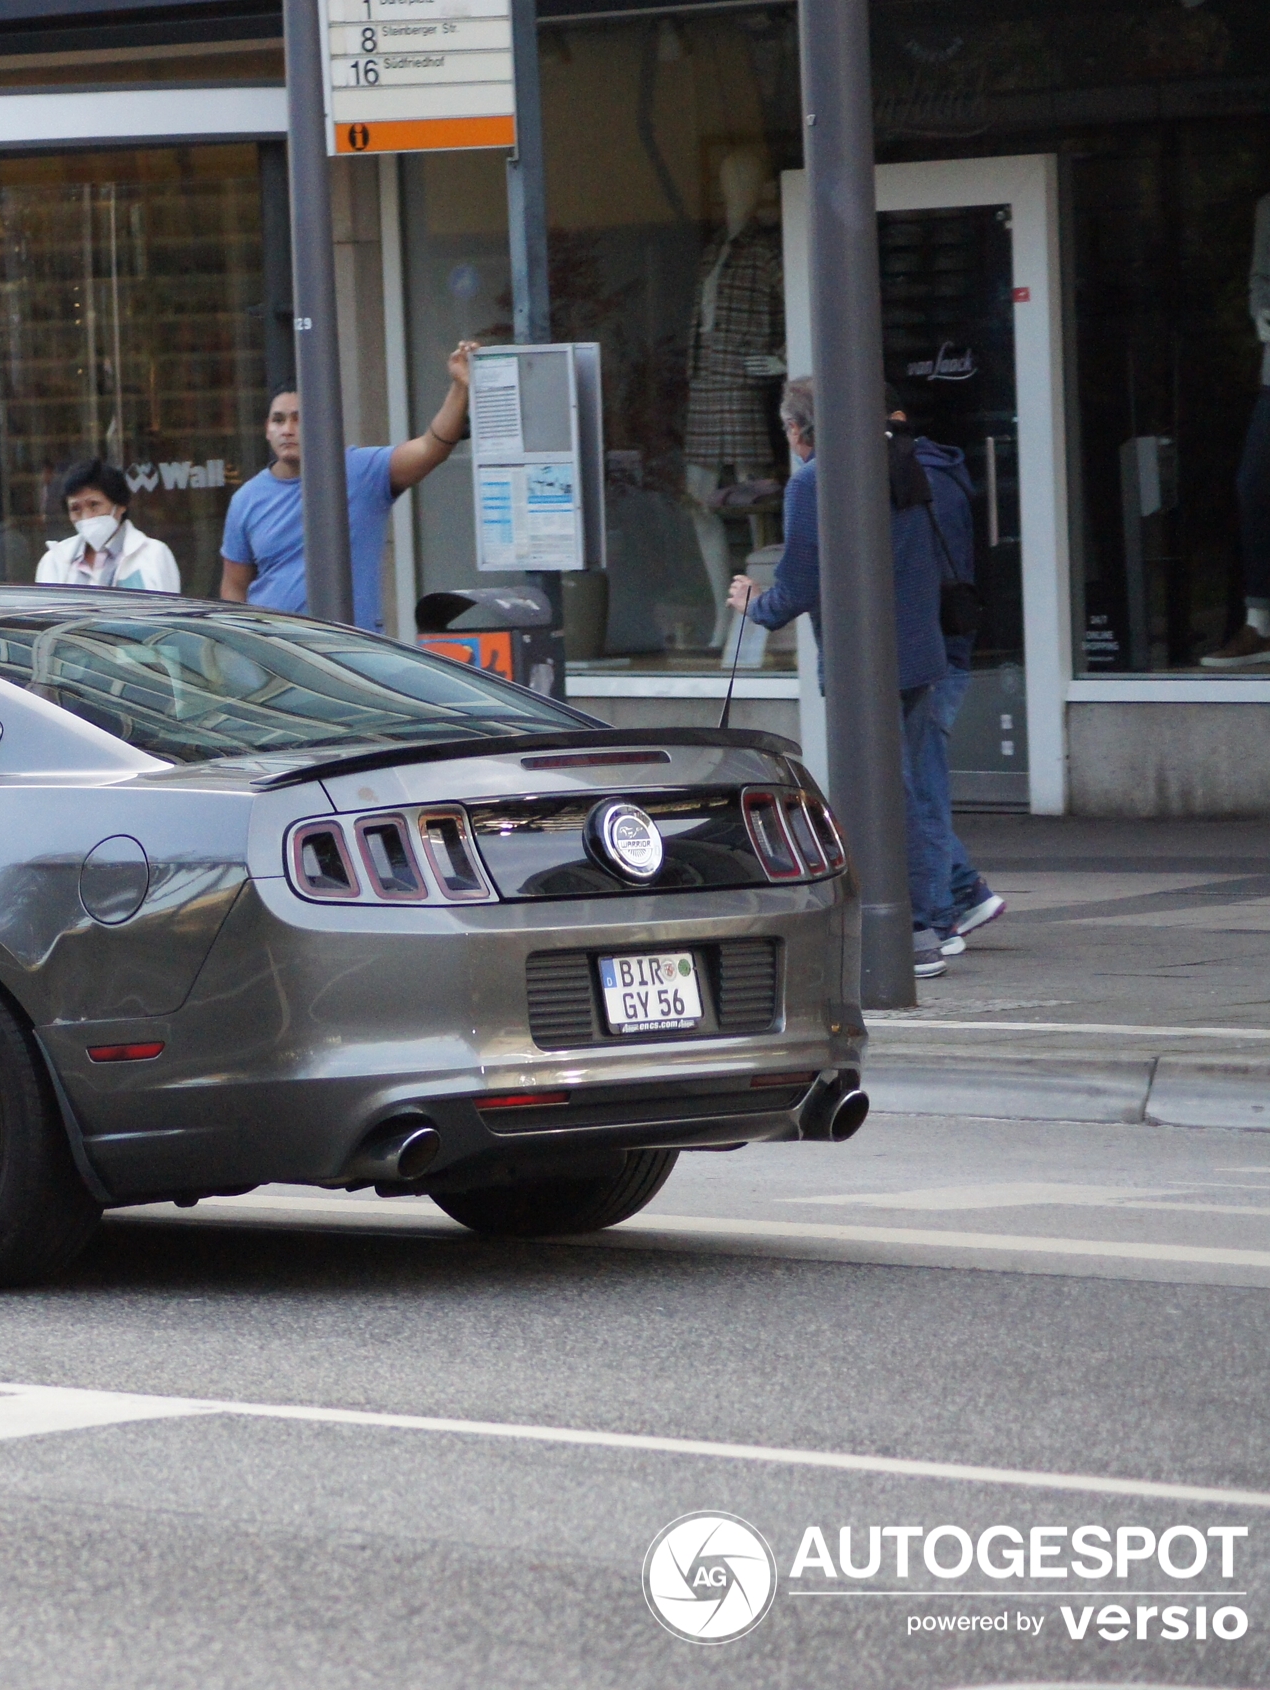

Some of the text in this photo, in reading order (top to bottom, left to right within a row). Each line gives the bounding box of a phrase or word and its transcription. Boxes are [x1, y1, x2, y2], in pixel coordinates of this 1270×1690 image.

[361, 27, 377, 53] 8
[350, 59, 379, 85] 16
[383, 56, 445, 69] Südfriedhof
[158, 459, 225, 490] Wall
[620, 840, 651, 849] WARRIOR
[606, 977, 613, 986] D
[619, 957, 664, 987] BIR
[622, 988, 685, 1019] GY 56
